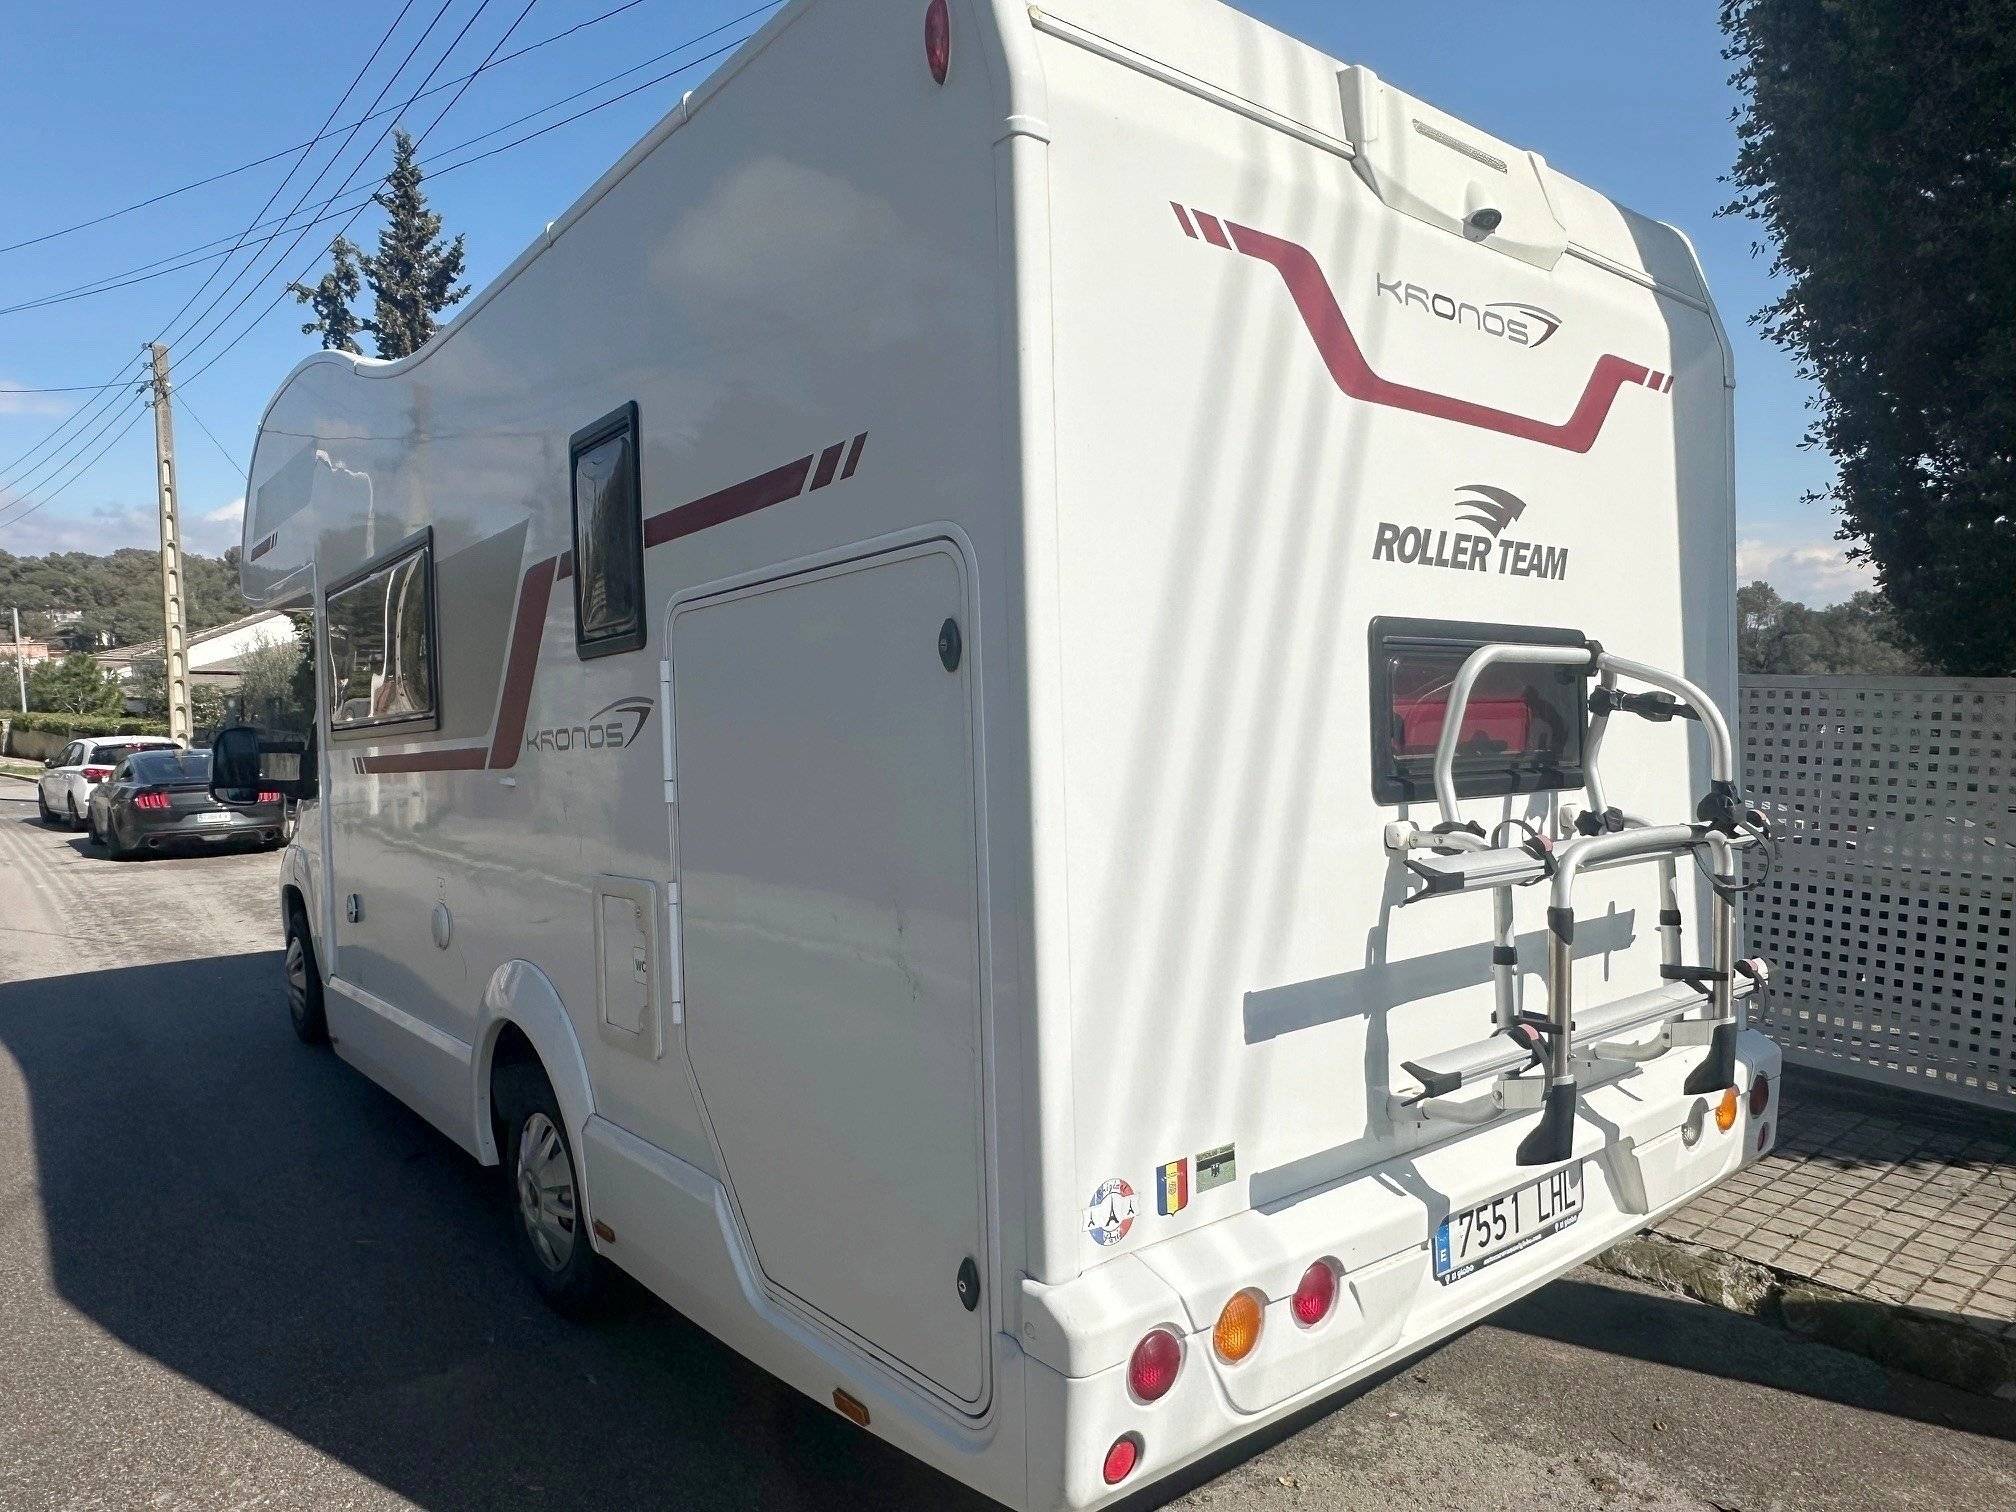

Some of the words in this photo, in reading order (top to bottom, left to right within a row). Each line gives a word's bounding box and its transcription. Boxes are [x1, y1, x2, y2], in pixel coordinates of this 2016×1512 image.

[1376, 272, 1529, 345] KRONOS
[1372, 521, 1493, 572] ROLLER
[1498, 538, 1569, 581] TEAM
[526, 722, 624, 752] KRONOS
[635, 960, 647, 973] WC
[1459, 1191, 1520, 1258] 7551
[1537, 1169, 1576, 1223] LHL
[1440, 1249, 1449, 1263] E
